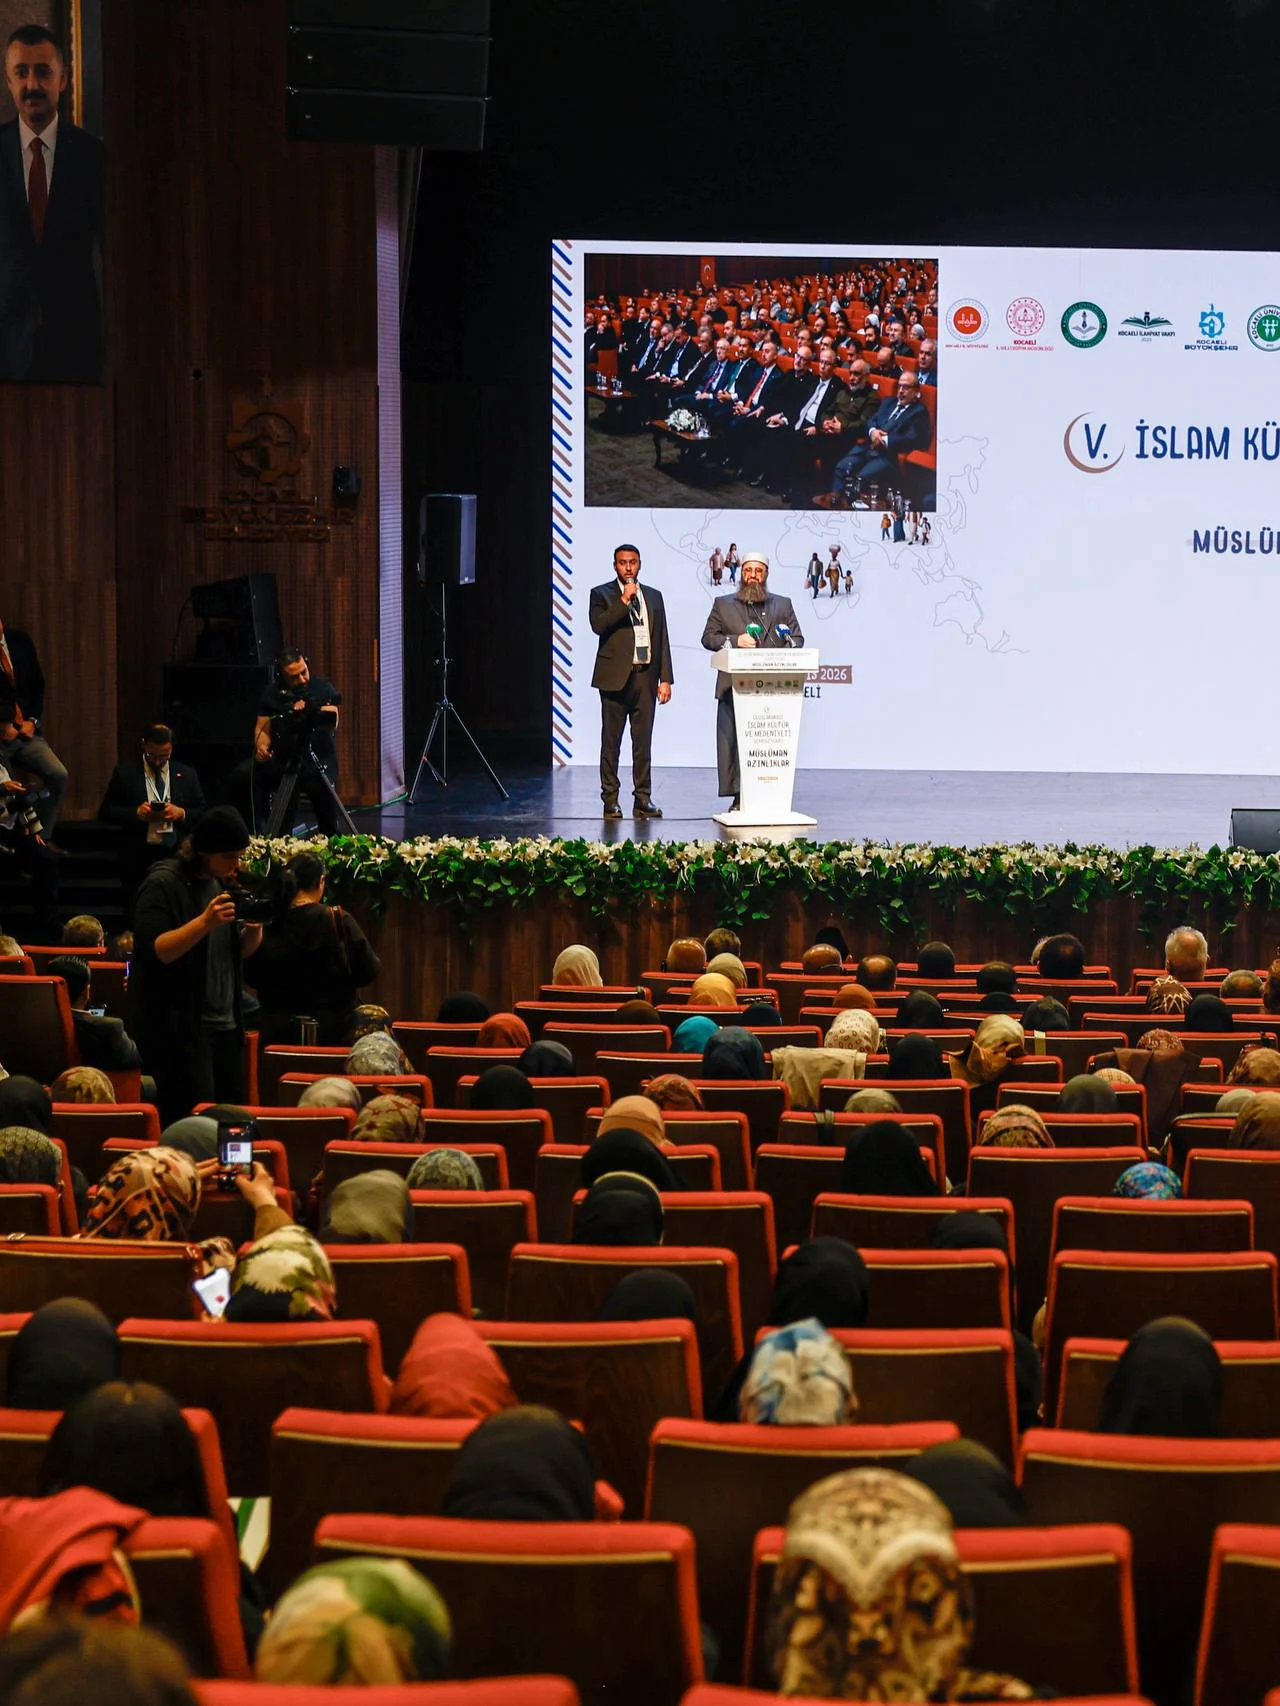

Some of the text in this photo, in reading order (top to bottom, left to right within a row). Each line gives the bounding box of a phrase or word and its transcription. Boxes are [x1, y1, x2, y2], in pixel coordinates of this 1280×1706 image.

[1084, 423, 1109, 460] V.
[1135, 418, 1231, 461] İSLAM
[820, 668, 848, 681] 2026
[749, 748, 788, 757] MÜSLÜMAN
[747, 759, 790, 768] AZINLIKLAR
